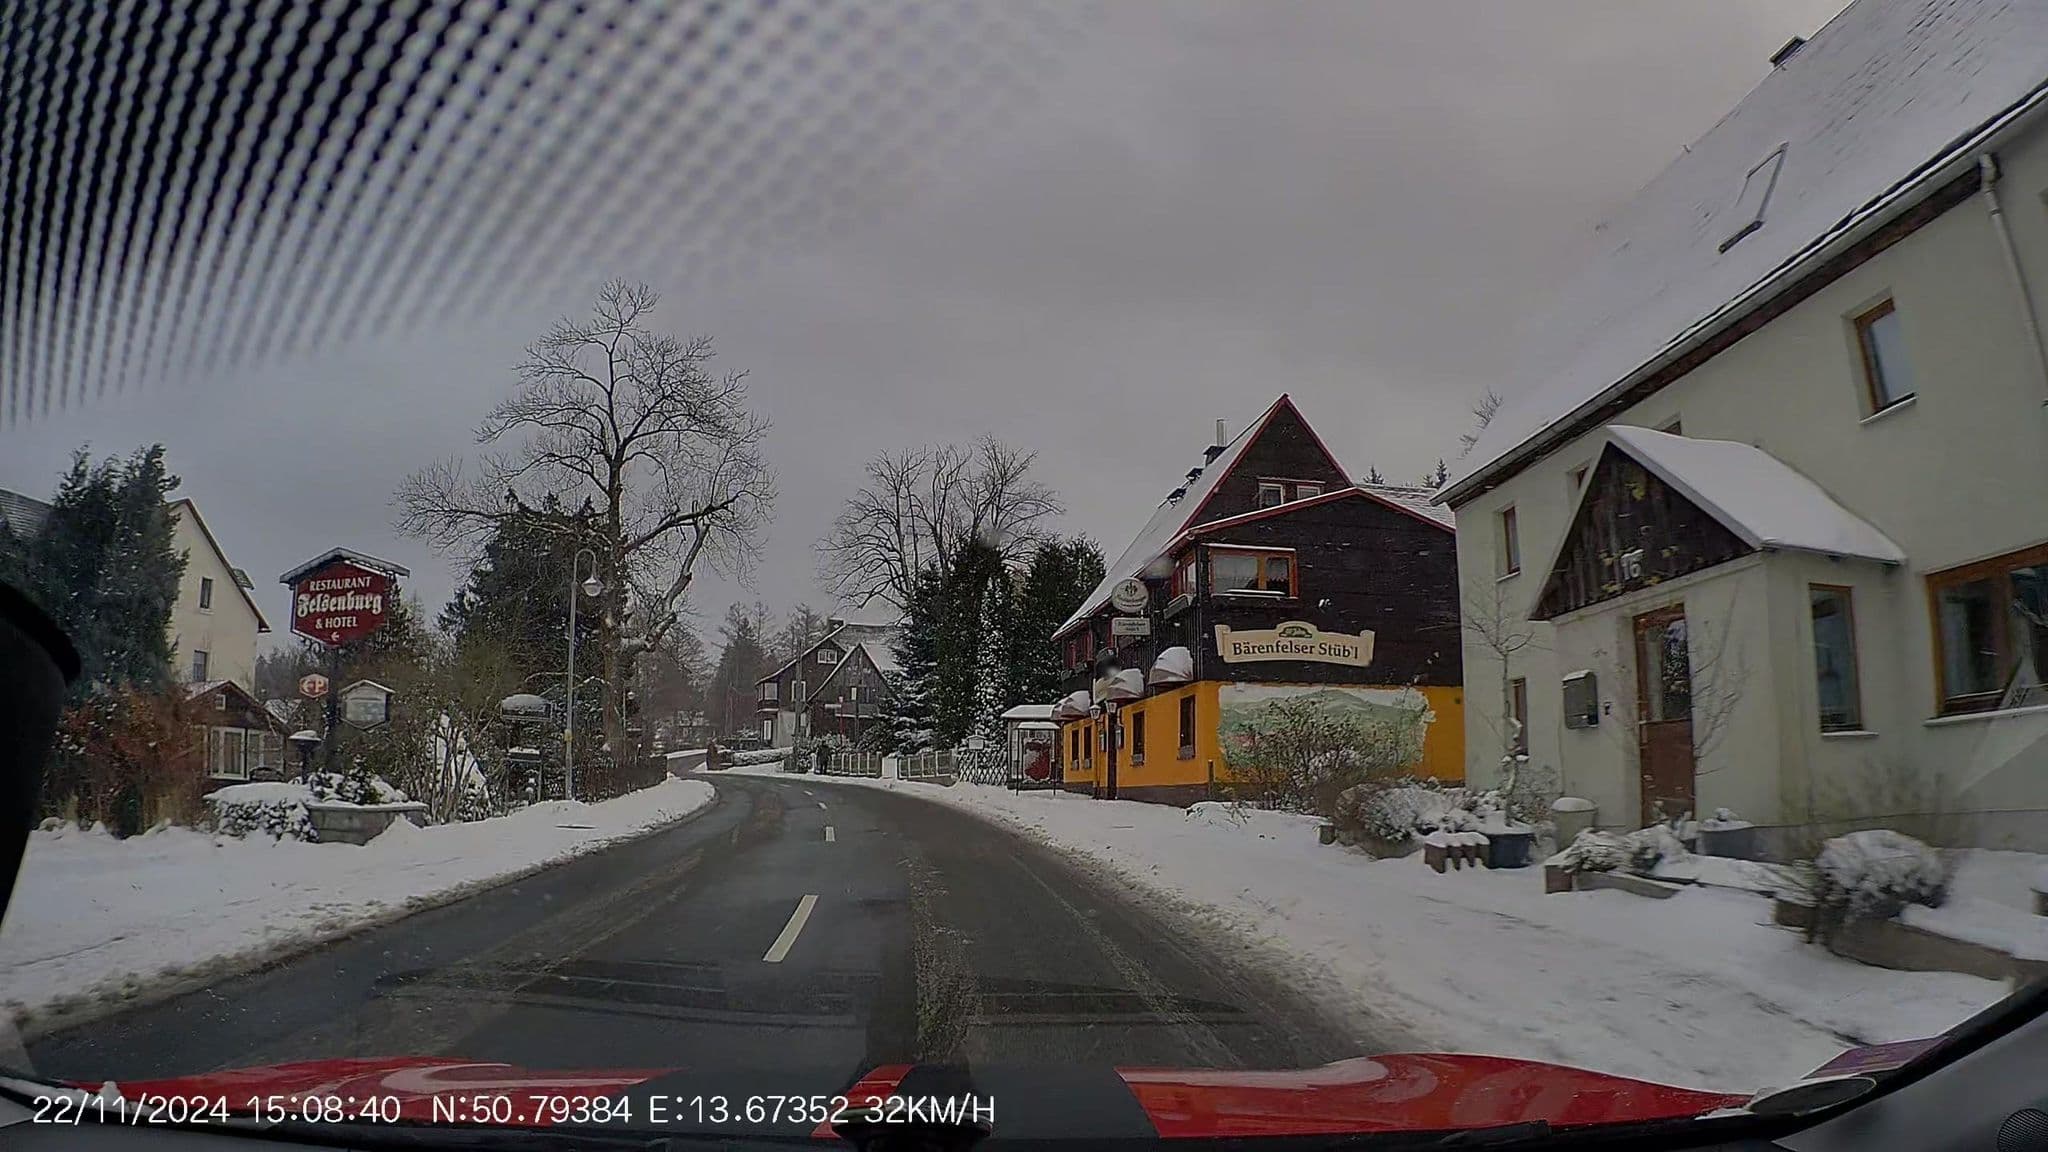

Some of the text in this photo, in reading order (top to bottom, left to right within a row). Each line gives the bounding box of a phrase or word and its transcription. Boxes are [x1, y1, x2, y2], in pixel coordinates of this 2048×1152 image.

[1621, 550, 1643, 580] 16
[309, 577, 371, 592] RESTAURANT
[297, 591, 383, 617] Felsenburg
[315, 616, 358, 629] & HOTEL
[1232, 640, 1315, 656] Bärenfelser
[315, 678, 324, 693] P
